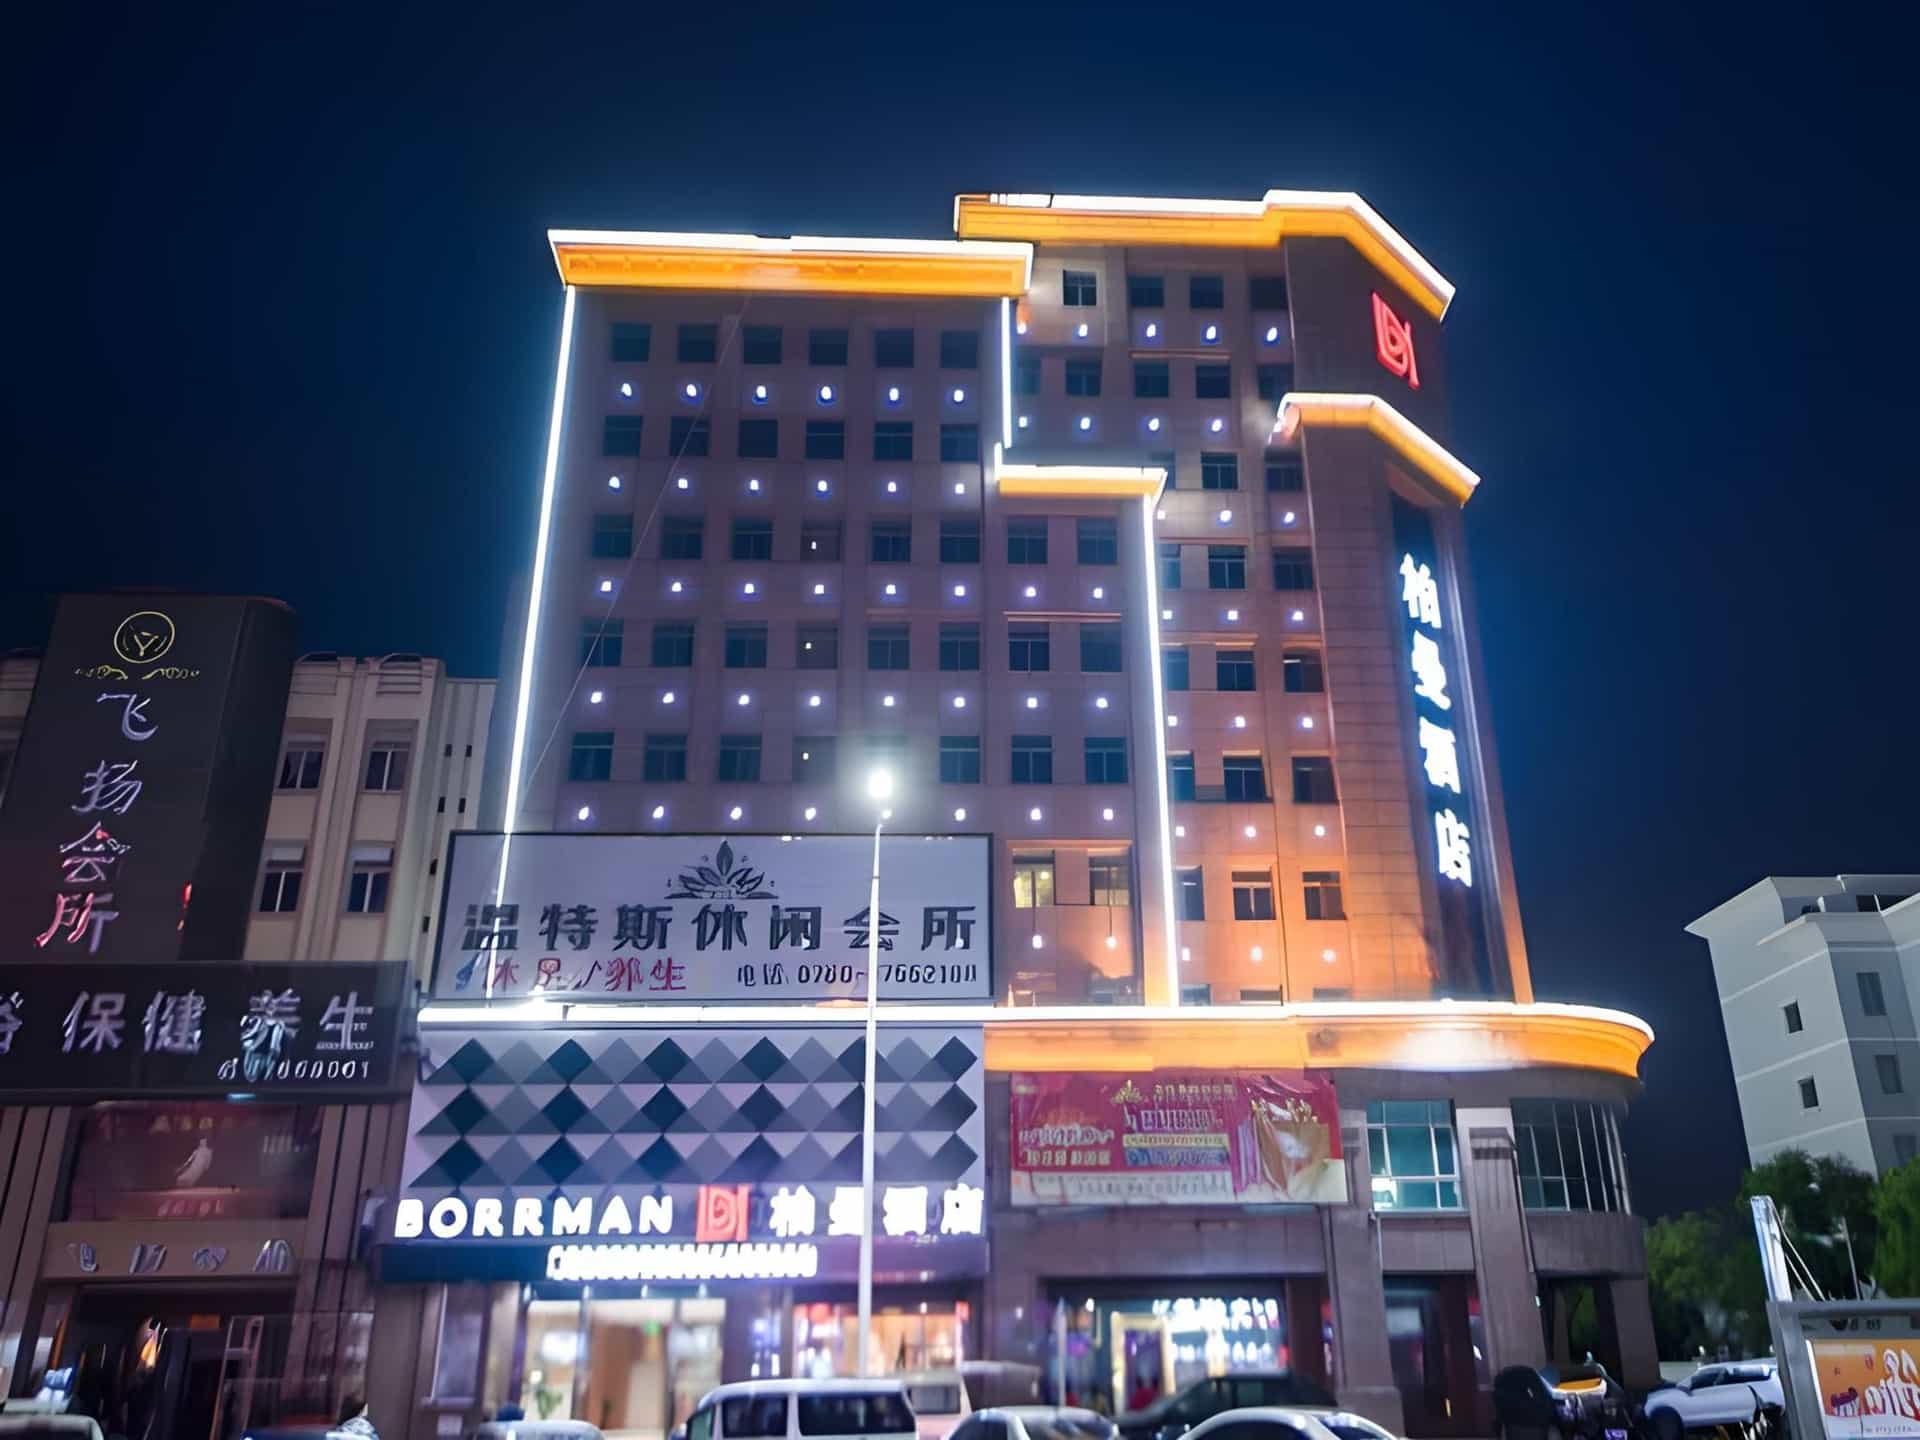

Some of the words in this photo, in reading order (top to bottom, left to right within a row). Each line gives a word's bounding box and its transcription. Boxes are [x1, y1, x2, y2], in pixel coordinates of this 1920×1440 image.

[34, 692, 159, 956] 飞扬会所
[461, 904, 976, 951] 温特斯休闲会所
[395, 1195, 672, 1238] BORRMAN
